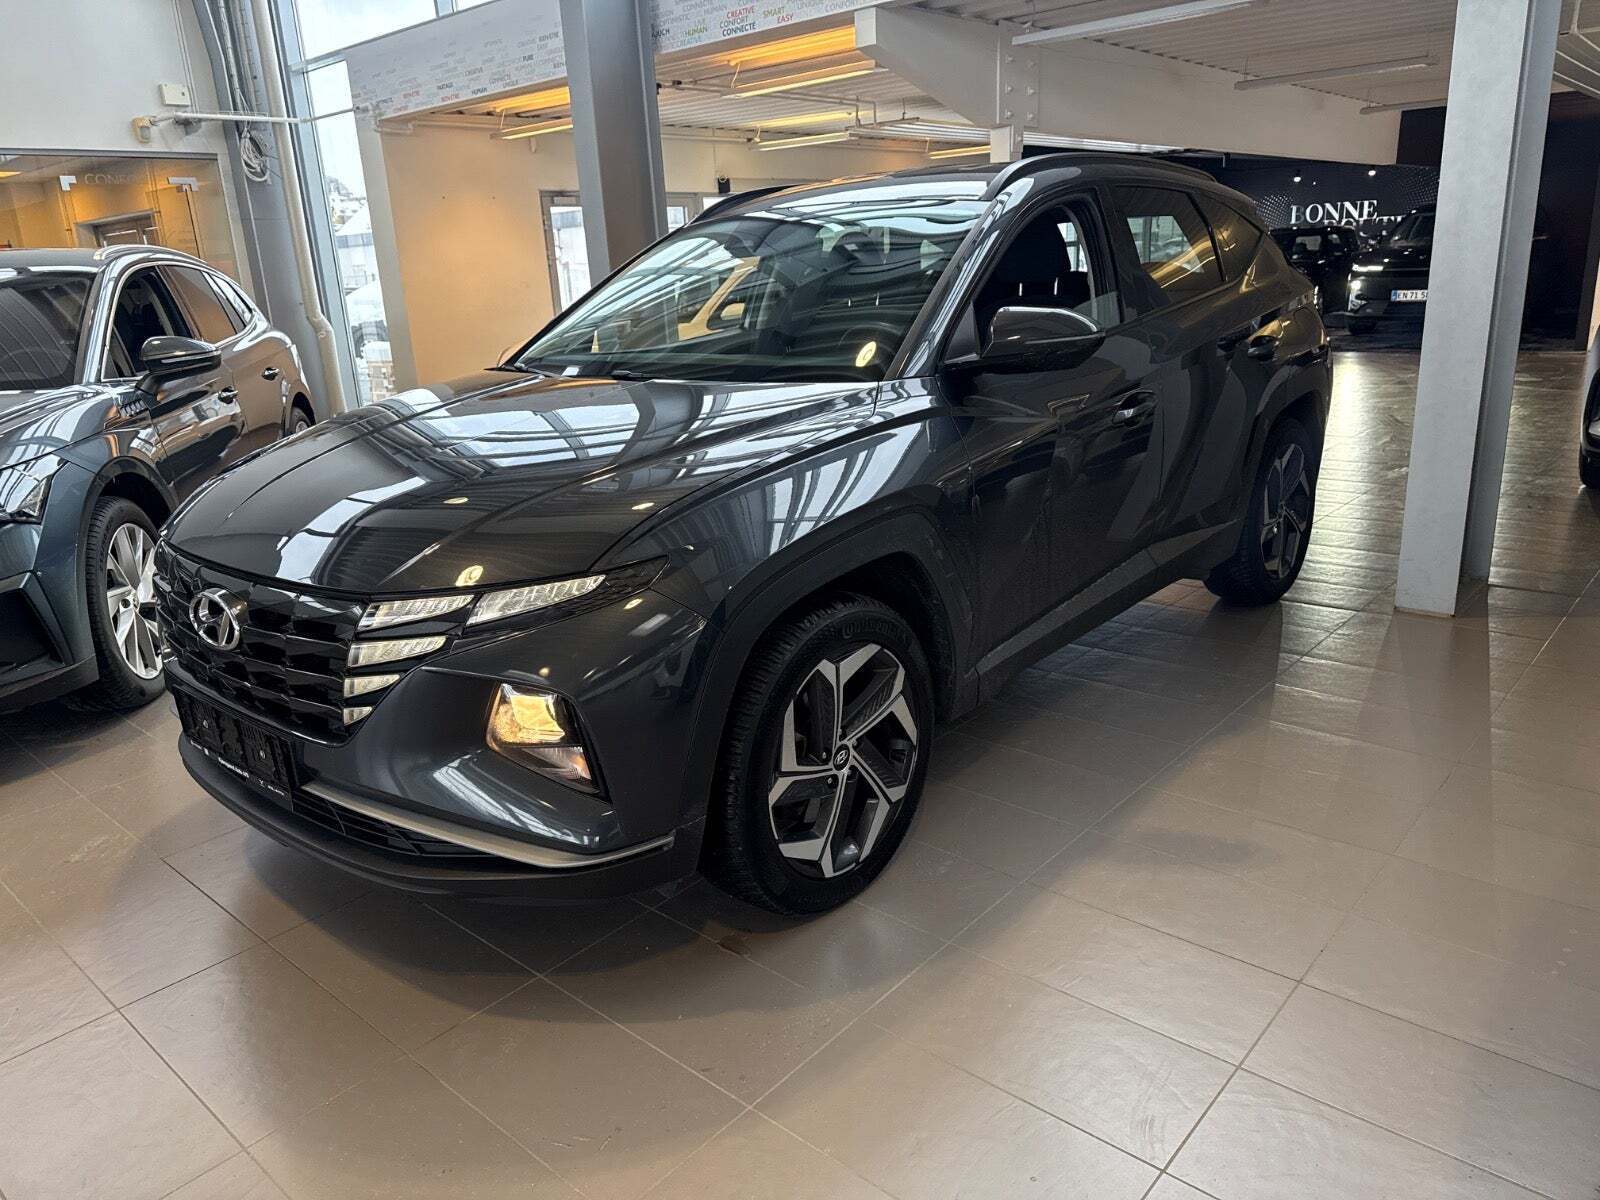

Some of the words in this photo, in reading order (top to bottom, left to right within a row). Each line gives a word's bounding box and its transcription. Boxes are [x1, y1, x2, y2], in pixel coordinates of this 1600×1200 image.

[726, 5, 756, 19] CREATIVE
[762, 7, 786, 18] SMART
[720, 16, 749, 29] CONFORT
[777, 14, 794, 25] EASY
[1290, 199, 1378, 224] BONNE
